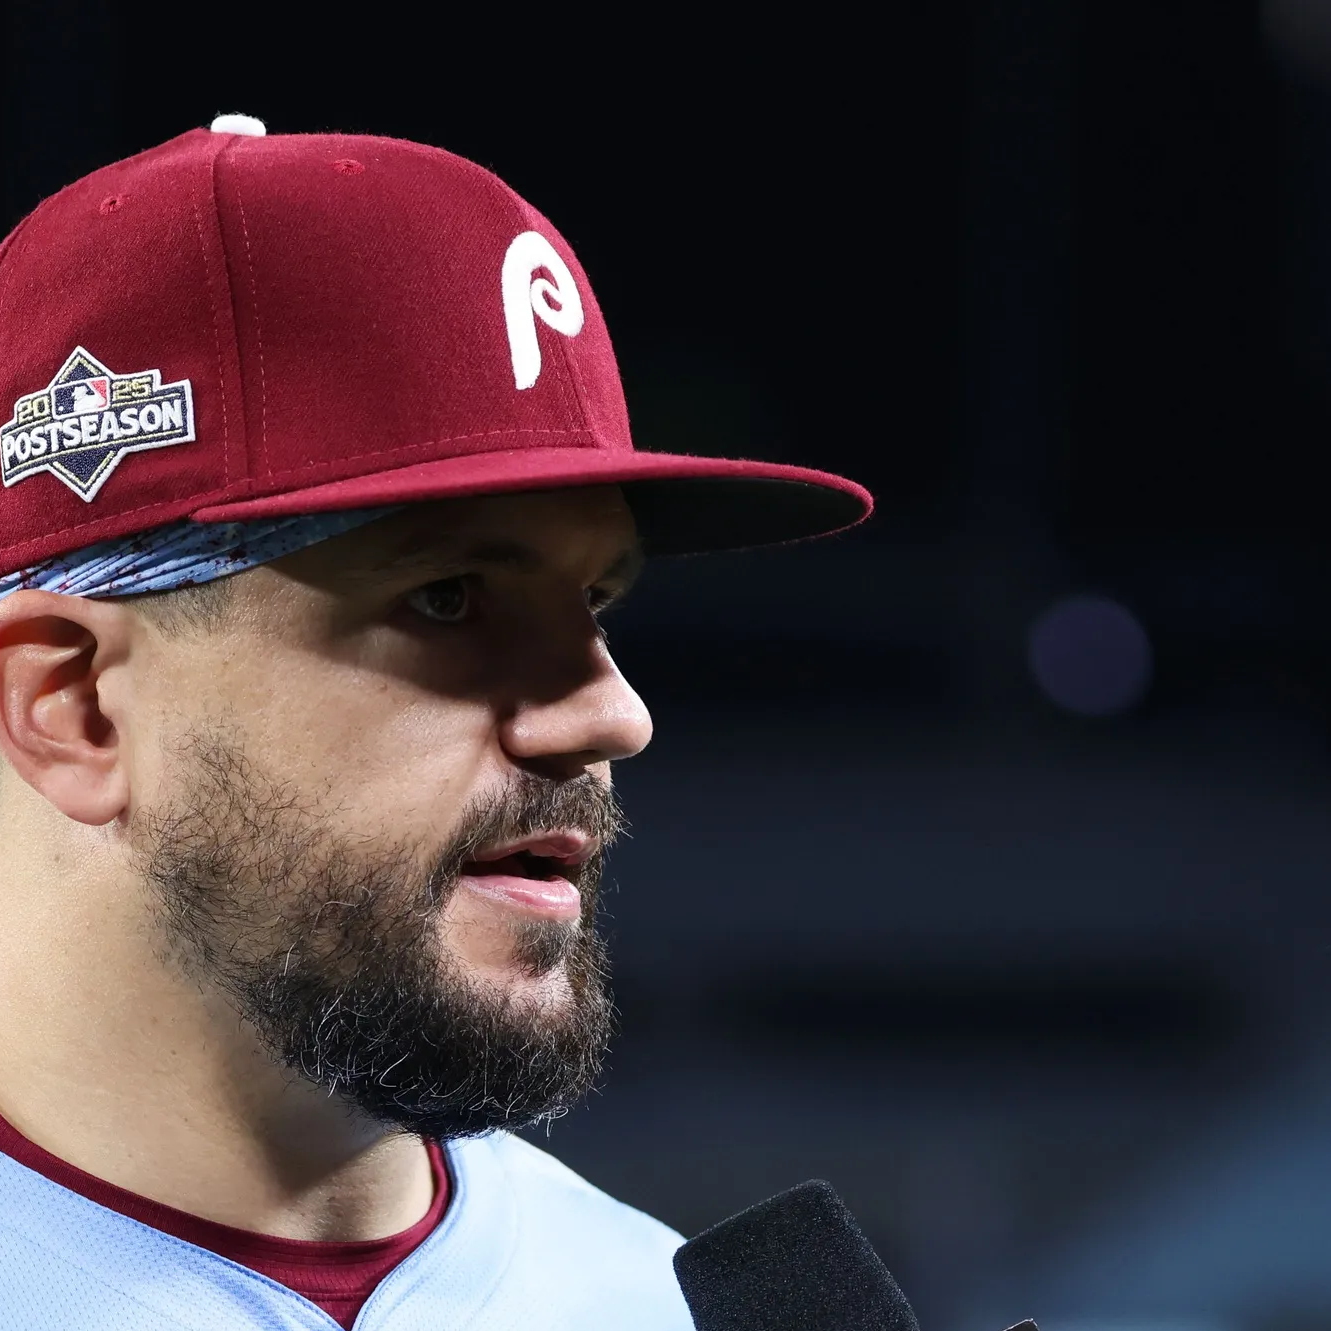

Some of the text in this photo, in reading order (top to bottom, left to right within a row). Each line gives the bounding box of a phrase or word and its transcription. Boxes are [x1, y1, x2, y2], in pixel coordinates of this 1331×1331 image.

[17, 376, 151, 424] 20 25
[2, 399, 182, 469] POSTSEASON
